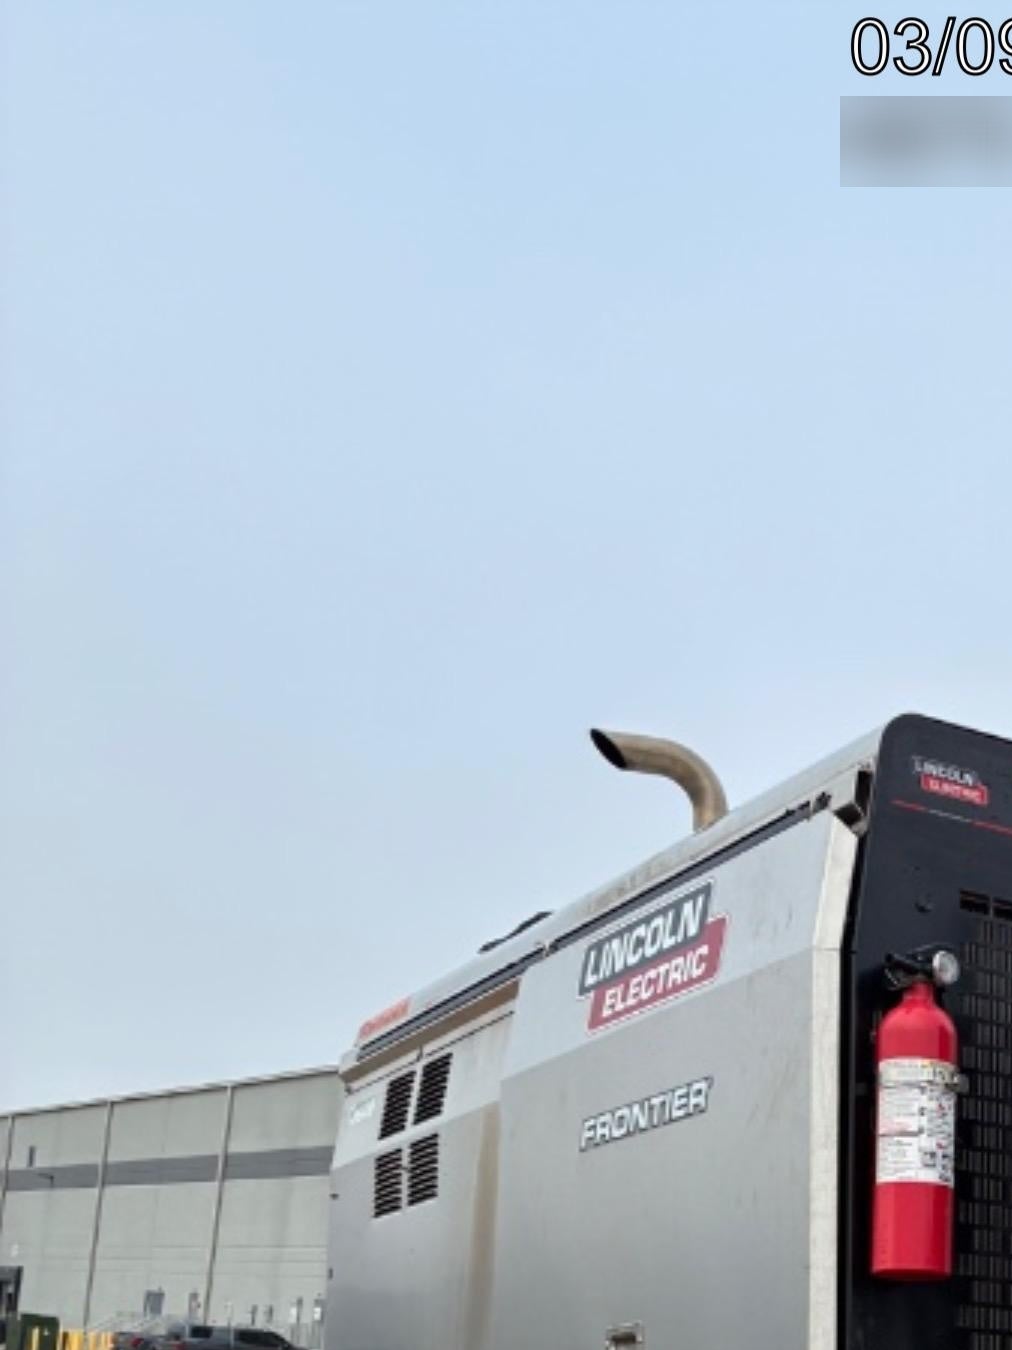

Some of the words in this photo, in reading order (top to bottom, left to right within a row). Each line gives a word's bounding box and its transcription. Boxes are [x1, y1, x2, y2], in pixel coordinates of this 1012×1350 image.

[583, 893, 706, 988] LINCOLN
[600, 943, 709, 1018] ELECTRIC
[579, 1077, 712, 1152] FRONTIER
